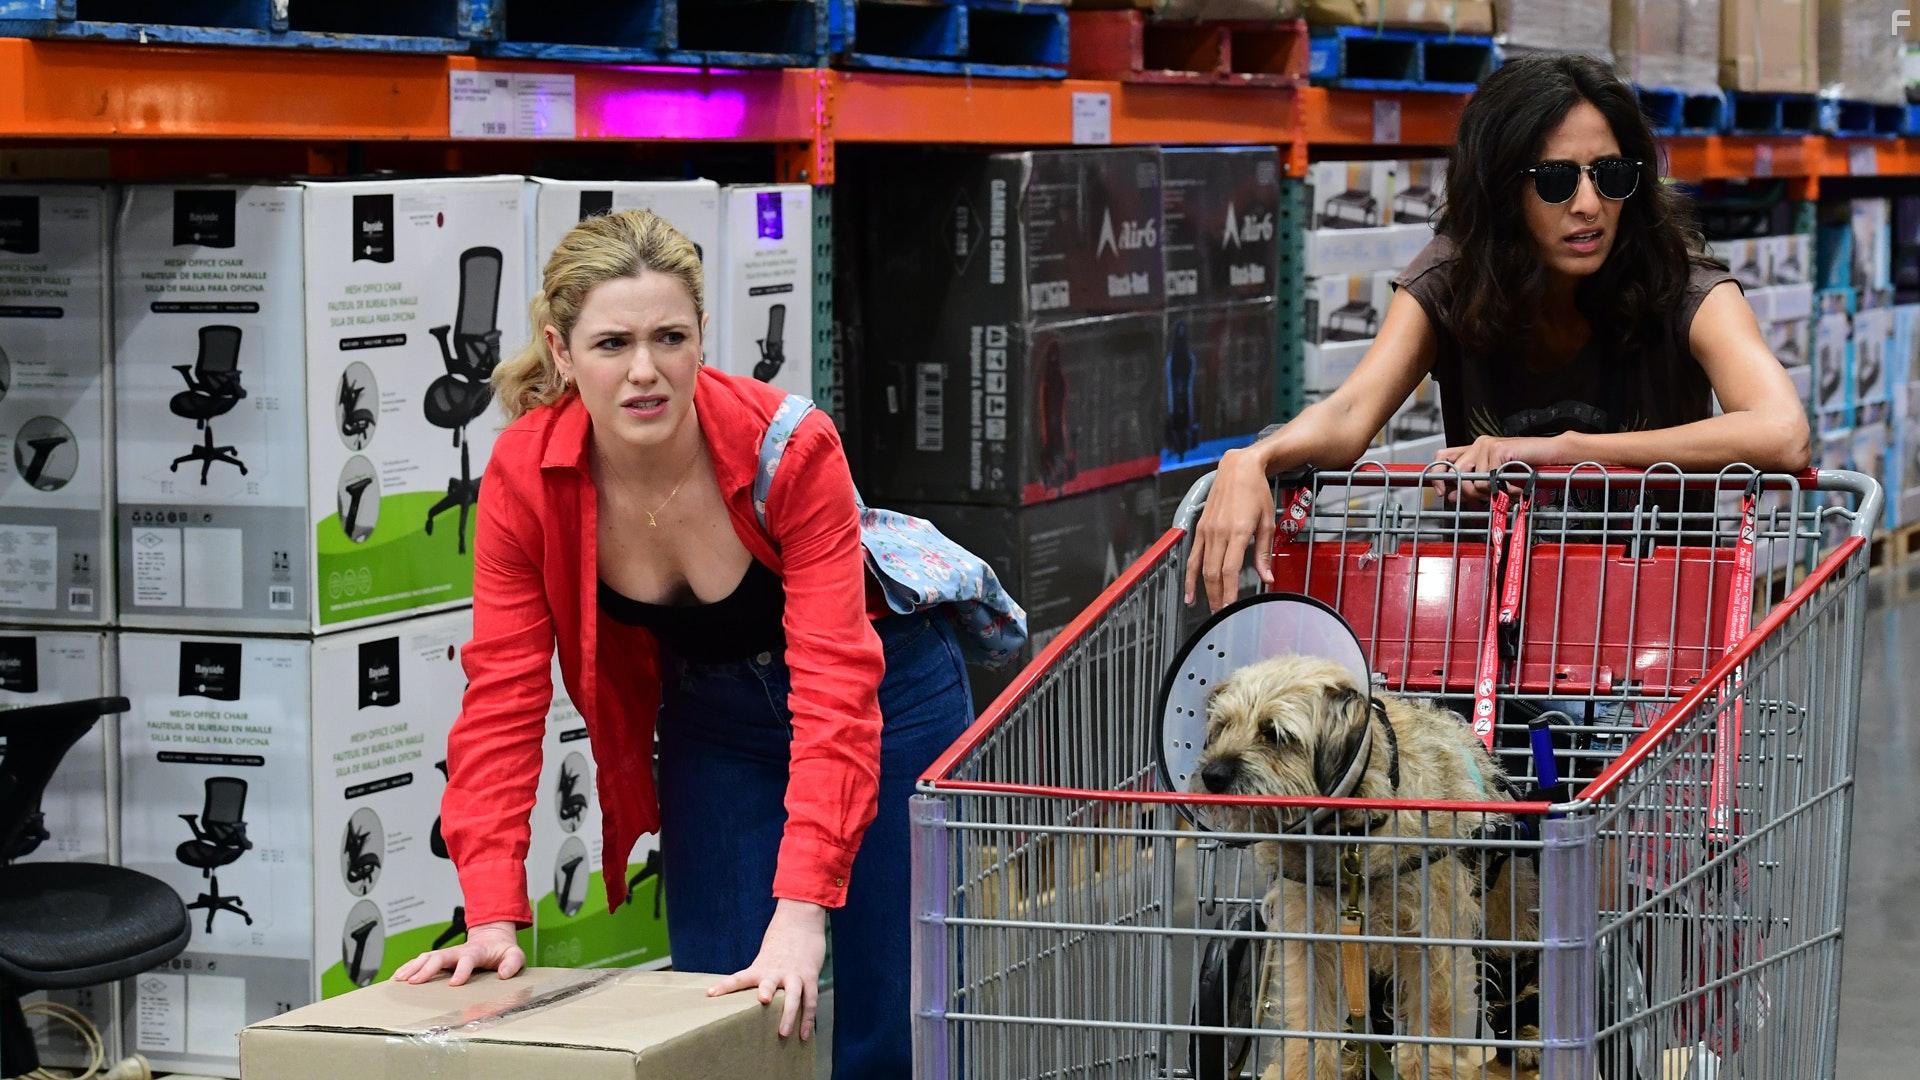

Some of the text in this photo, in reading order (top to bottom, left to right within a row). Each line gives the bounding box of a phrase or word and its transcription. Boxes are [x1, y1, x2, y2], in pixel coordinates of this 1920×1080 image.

[990, 178, 1006, 284] GAMING CHAIR
[164, 259, 244, 267] MESH OFFICE CHAIR
[180, 272, 189, 280] DE
[192, 271, 224, 280] BUREAU
[227, 272, 238, 280] EN
[240, 272, 267, 280] MAILLE
[180, 284, 205, 293] MALLA
[208, 285, 228, 293] PARA
[230, 285, 265, 293] OFICINA
[363, 283, 382, 293] OFFICE
[384, 282, 401, 292] CHAIR
[1740, 547, 1746, 555] Do
[1512, 565, 1520, 583] Leave
[1735, 569, 1743, 588] Leave
[1509, 597, 1516, 605] Do
[1734, 588, 1742, 605] Child
[1737, 551, 1753, 640] Please Fasten Child Securely
[1730, 606, 1740, 642] Unattended
[0, 658, 21, 671] ayside
[195, 663, 225, 678] Bayside
[169, 709, 249, 720] MESH OFFICE CHAIR
[146, 721, 272, 734] FAUTEUIL DE BUREAU EN MAILLE
[369, 727, 388, 740] OFFICE
[390, 722, 408, 734] CHAIR
[151, 733, 270, 746] SILLA DE MALLA PARA OFICINA
[398, 750, 422, 763] OFICINA
